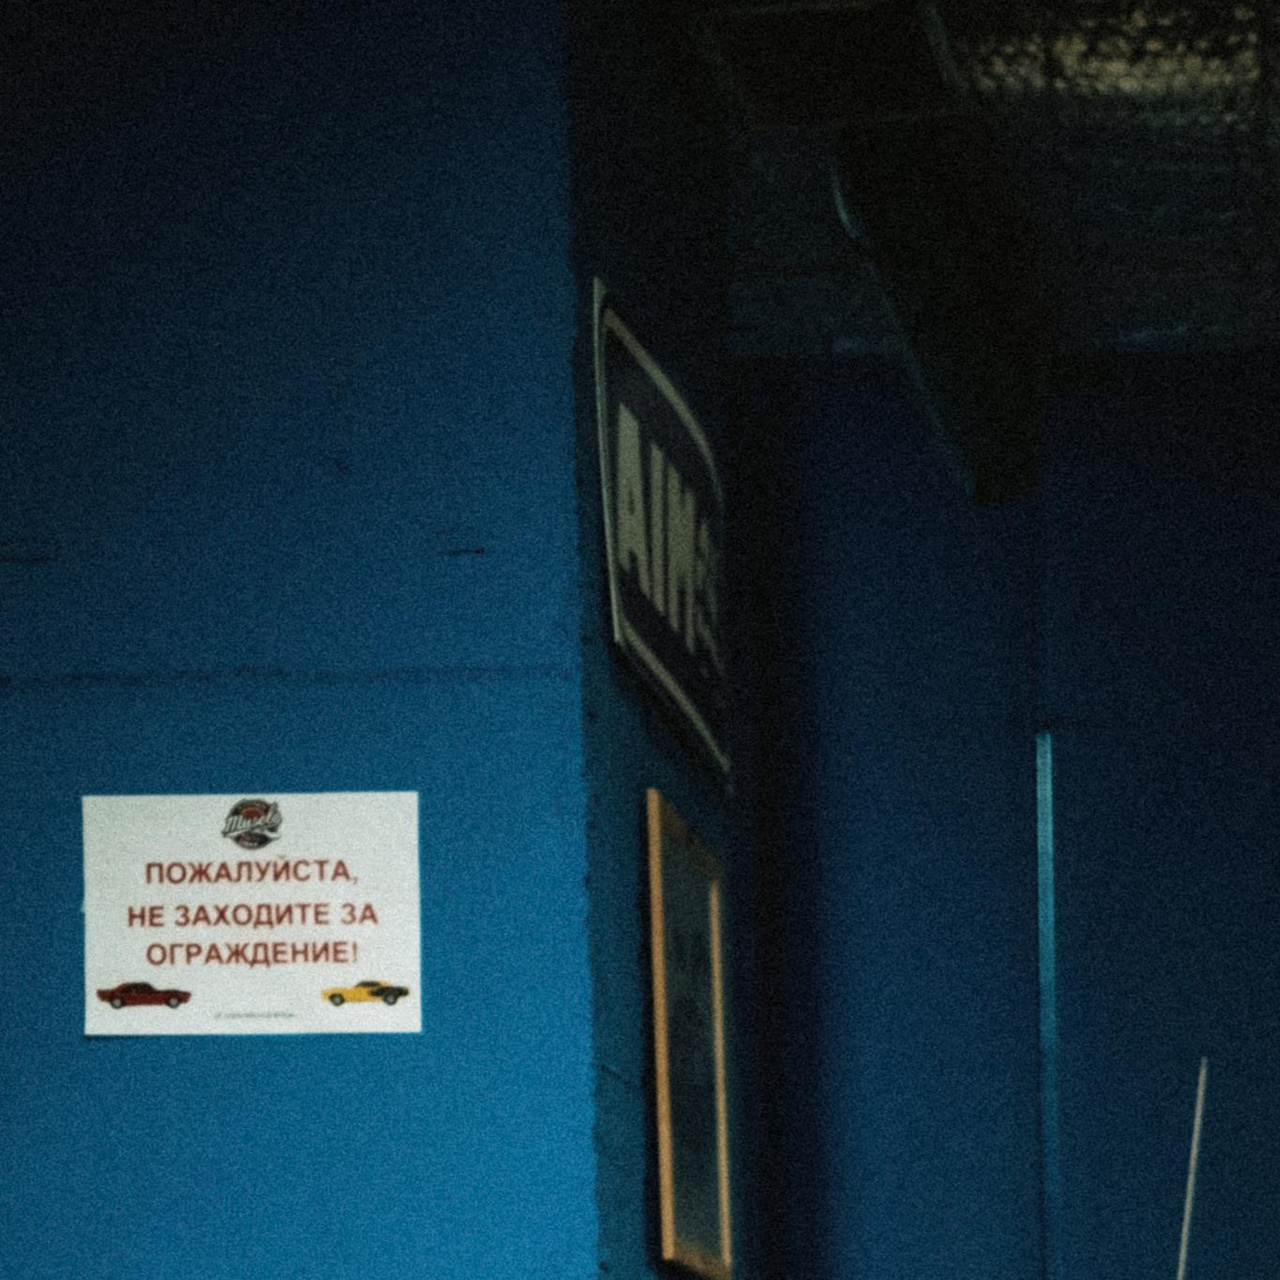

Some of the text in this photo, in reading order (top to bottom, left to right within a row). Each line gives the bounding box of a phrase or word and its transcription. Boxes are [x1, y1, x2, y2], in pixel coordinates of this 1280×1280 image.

[145, 855, 359, 886] ПОЖАЛУЙСТА,
[127, 902, 379, 930] НЕ ЗАХОДИТЕ ЗА
[145, 941, 359, 968] ОГРАЖДЕНИЕ!
